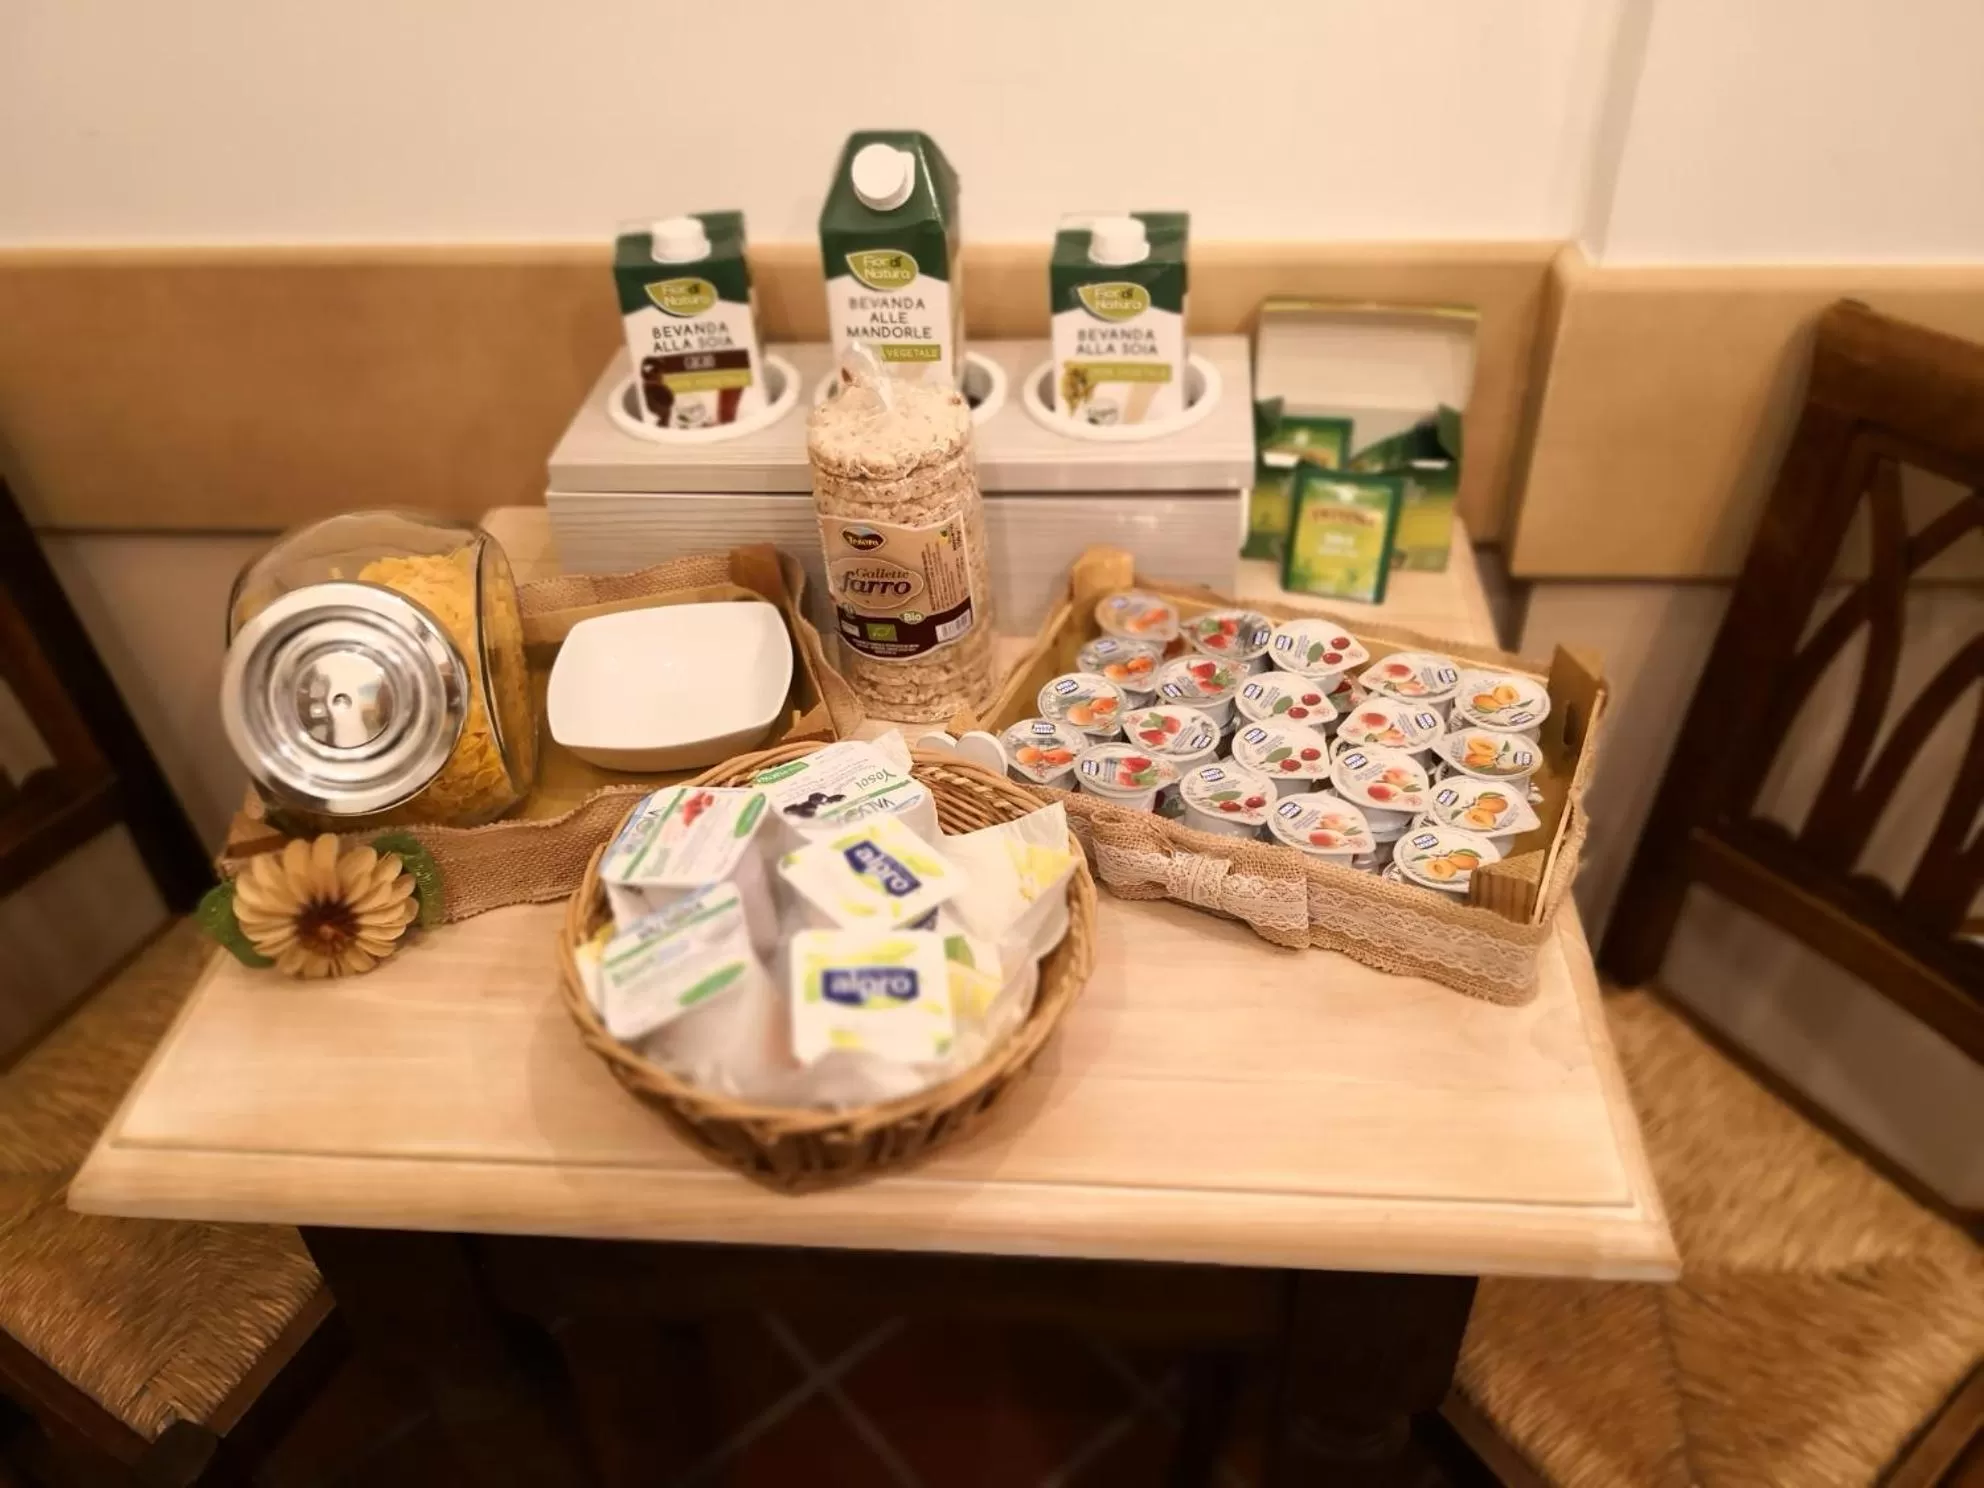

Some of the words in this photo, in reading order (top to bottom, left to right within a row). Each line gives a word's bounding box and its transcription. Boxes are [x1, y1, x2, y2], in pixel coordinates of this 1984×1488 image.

[847, 297, 926, 310] BEVANDA
[869, 312, 909, 324] ALLE
[652, 321, 729, 339] BEVANDA
[846, 326, 933, 340] MANDORLE
[1077, 328, 1156, 340] BEVANDA
[653, 339, 693, 353] ALLA
[1076, 343, 1117, 355] ALLA
[1122, 343, 1159, 355] SOIA
[840, 570, 912, 596] farro
[903, 612, 922, 622] Bio
[831, 970, 912, 999] alpro
